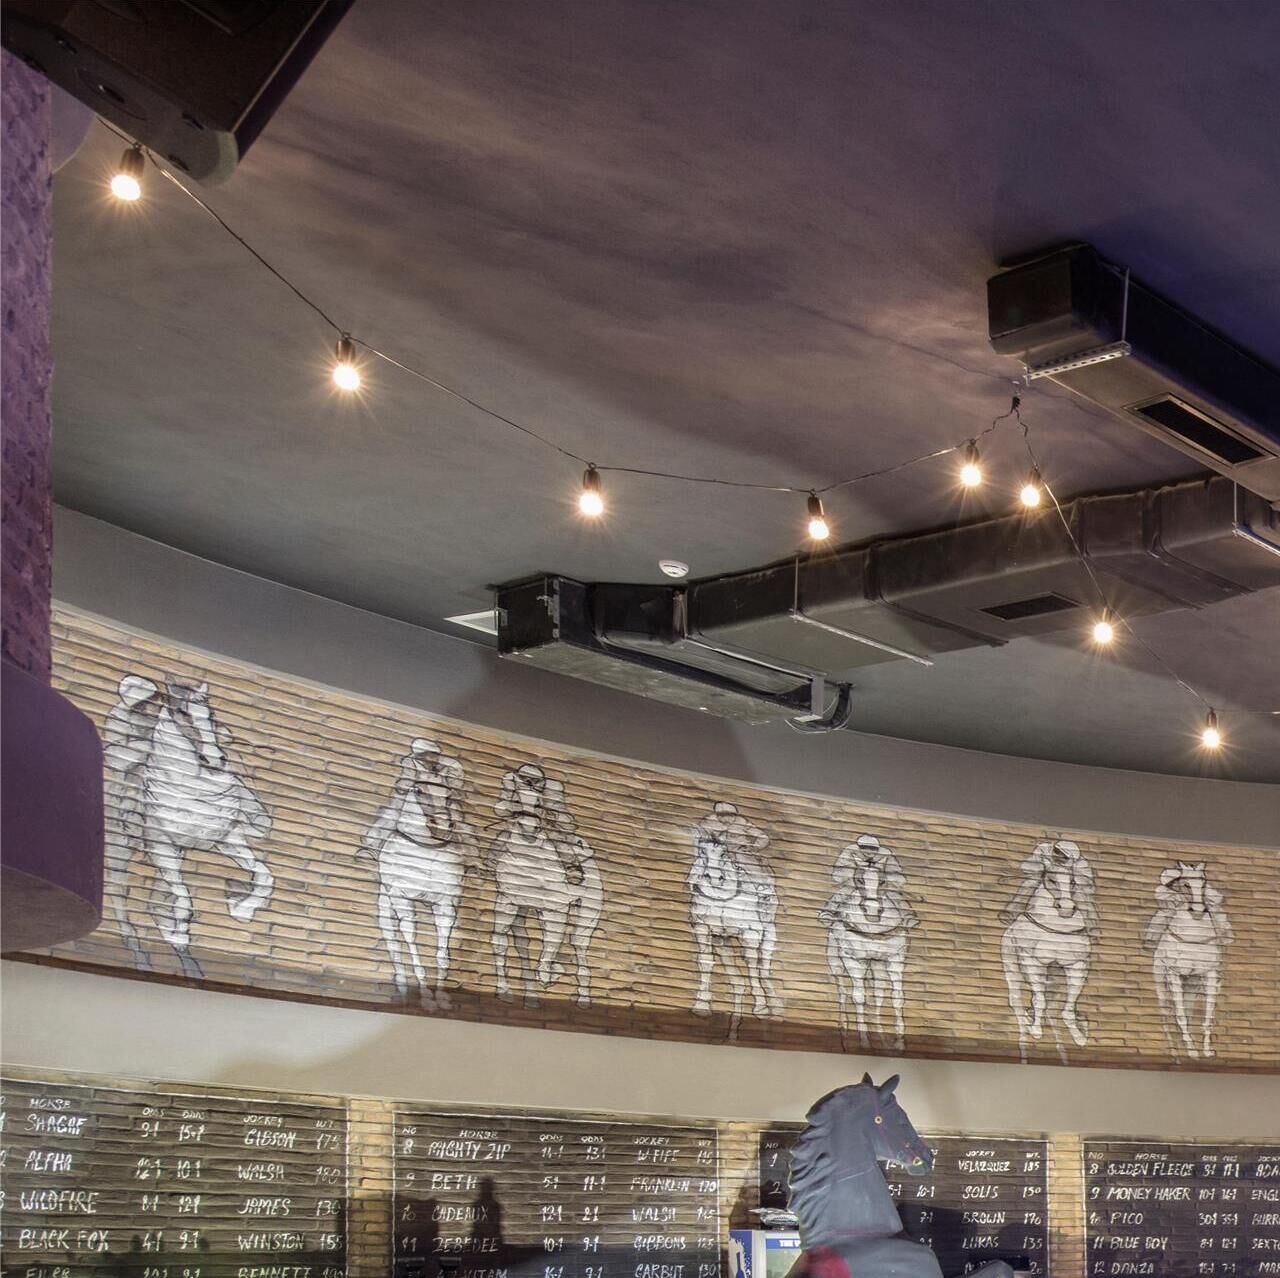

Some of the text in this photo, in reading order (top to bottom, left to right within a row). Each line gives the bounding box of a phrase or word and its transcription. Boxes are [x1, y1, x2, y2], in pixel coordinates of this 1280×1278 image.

[244, 1129, 297, 1149] GIBSON
[428, 1140, 481, 1160] MIGHTY
[483, 1143, 511, 1160] ZIP
[25, 1150, 73, 1172] ALPHA
[238, 1163, 285, 1181] WALSH
[958, 1159, 1011, 1173] VELAZQUEZ
[1152, 1162, 1195, 1177] FLEECE
[432, 1173, 478, 1190] BETH
[630, 1176, 690, 1194] FRANKLIN
[962, 1185, 999, 1199] SOLIS
[1106, 1187, 1152, 1200] MONEY
[20, 1190, 99, 1214] WILDFIRE
[238, 1198, 292, 1216] JAMES
[431, 1203, 489, 1223] CADEAUX
[631, 1206, 676, 1222] WALSH
[961, 1211, 1006, 1225] BROWN
[1110, 1211, 1144, 1225] PICO
[19, 1229, 70, 1250] BLACK
[77, 1229, 109, 1252] FOX
[238, 1232, 305, 1251] WINSTON
[634, 1235, 686, 1251] GIBBONS
[962, 1236, 1000, 1249] LUKAS
[1110, 1236, 1140, 1250] BLUE
[1145, 1237, 1168, 1250] BOY
[1111, 1262, 1154, 1274] DANZA
